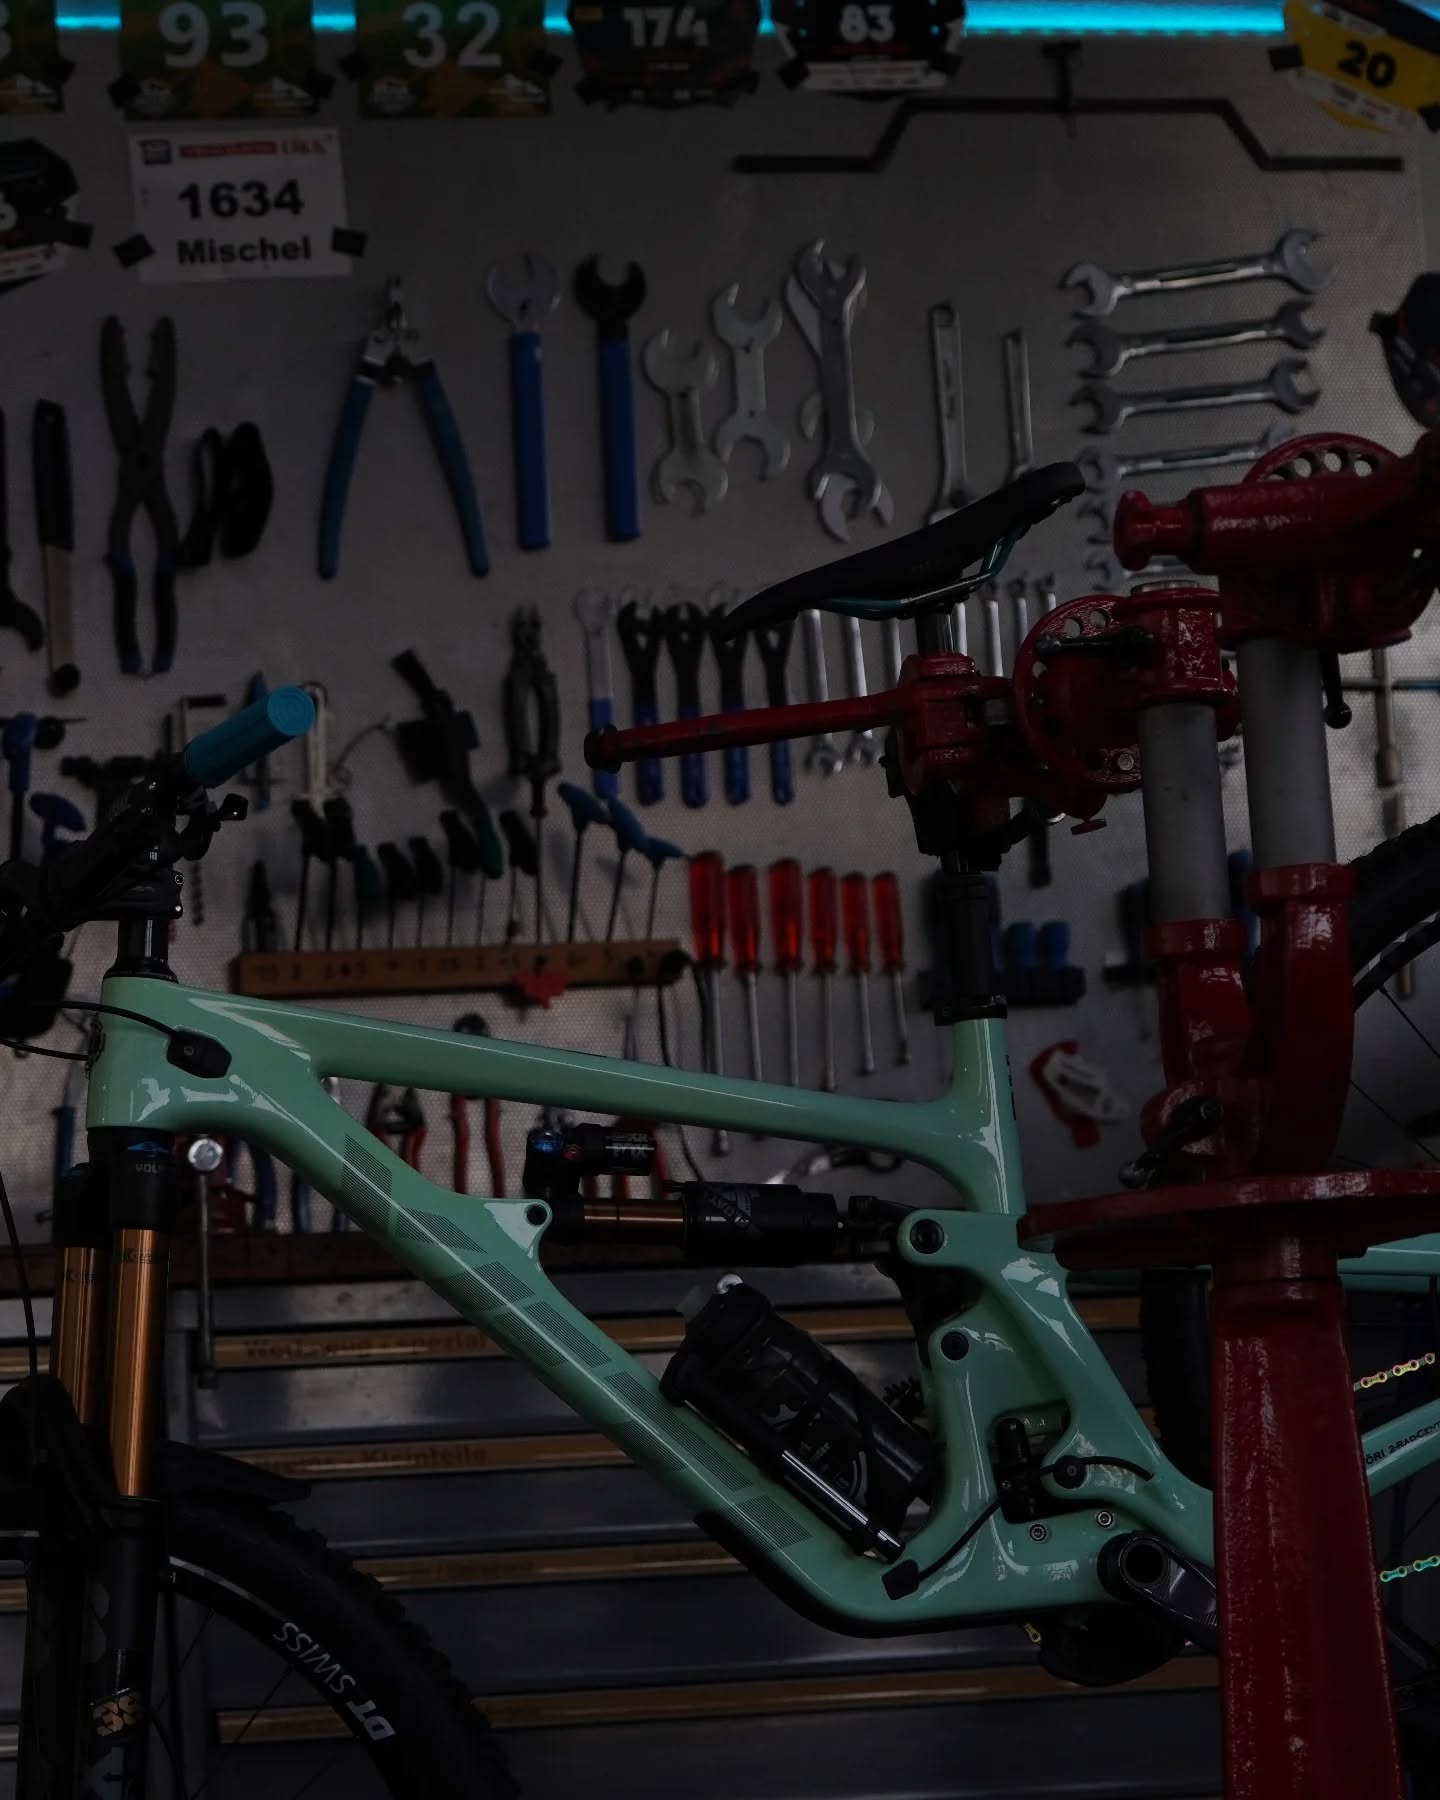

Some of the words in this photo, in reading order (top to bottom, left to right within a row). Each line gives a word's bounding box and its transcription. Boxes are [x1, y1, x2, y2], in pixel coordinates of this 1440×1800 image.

[158, 1, 269, 69] 93
[402, 2, 501, 69] 32
[622, 5, 708, 48] 174
[1339, 41, 1396, 87] 20
[179, 179, 304, 219] 1634
[178, 236, 311, 264] Mischel
[271, 1622, 358, 1695] SWISS
[346, 1699, 397, 1742] DT
